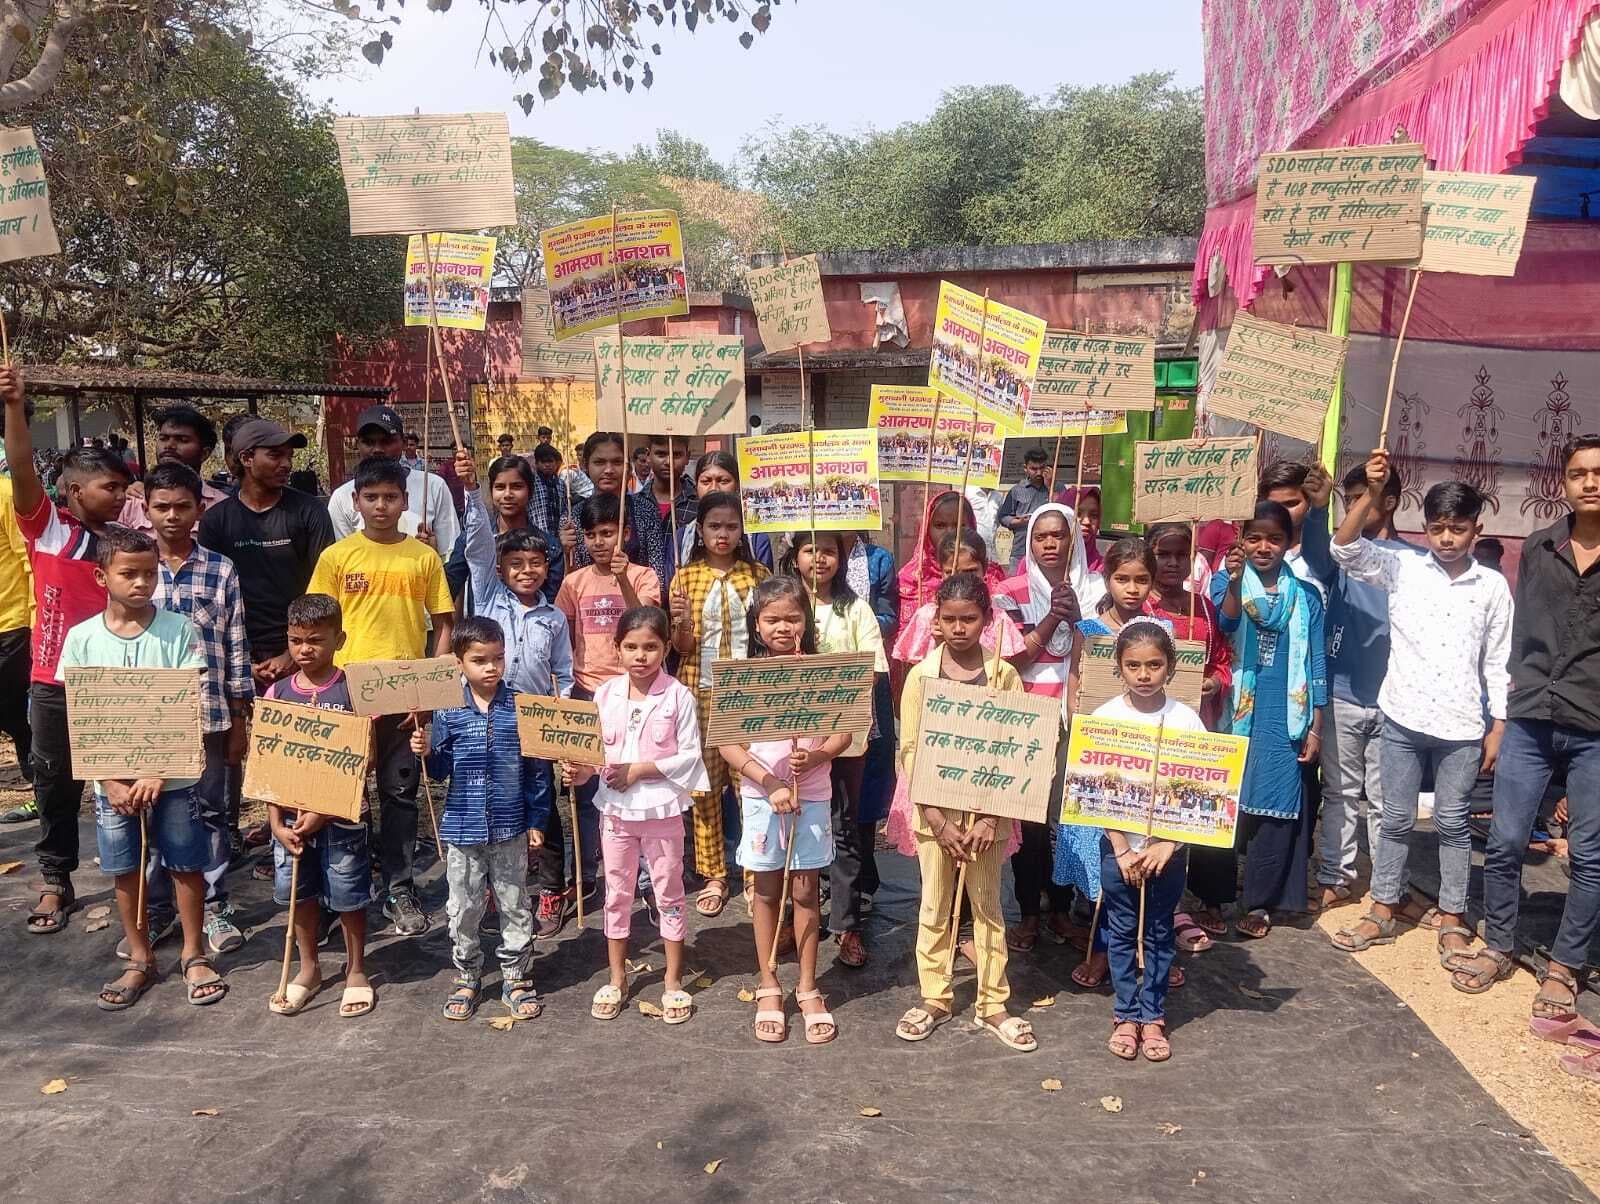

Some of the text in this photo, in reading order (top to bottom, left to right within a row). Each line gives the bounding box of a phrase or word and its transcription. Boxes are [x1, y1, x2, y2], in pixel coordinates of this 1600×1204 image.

[1284, 182, 1308, 197] 108
[436, 262, 483, 277] अनशन
[554, 251, 605, 278] आमरण
[608, 243, 672, 265] अनशन
[942, 318, 981, 348] आमरण
[982, 337, 1031, 369] अनशन
[877, 415, 996, 434] आमरण अनशन
[750, 462, 810, 480] आमरण
[815, 461, 869, 475] अनशन
[345, 572, 365, 582] PEPE
[345, 581, 369, 590] JEANS
[260, 706, 293, 727] BDO
[560, 710, 599, 728] एकता
[1079, 749, 1154, 773] आमरण
[1157, 761, 1231, 784] अनशन
